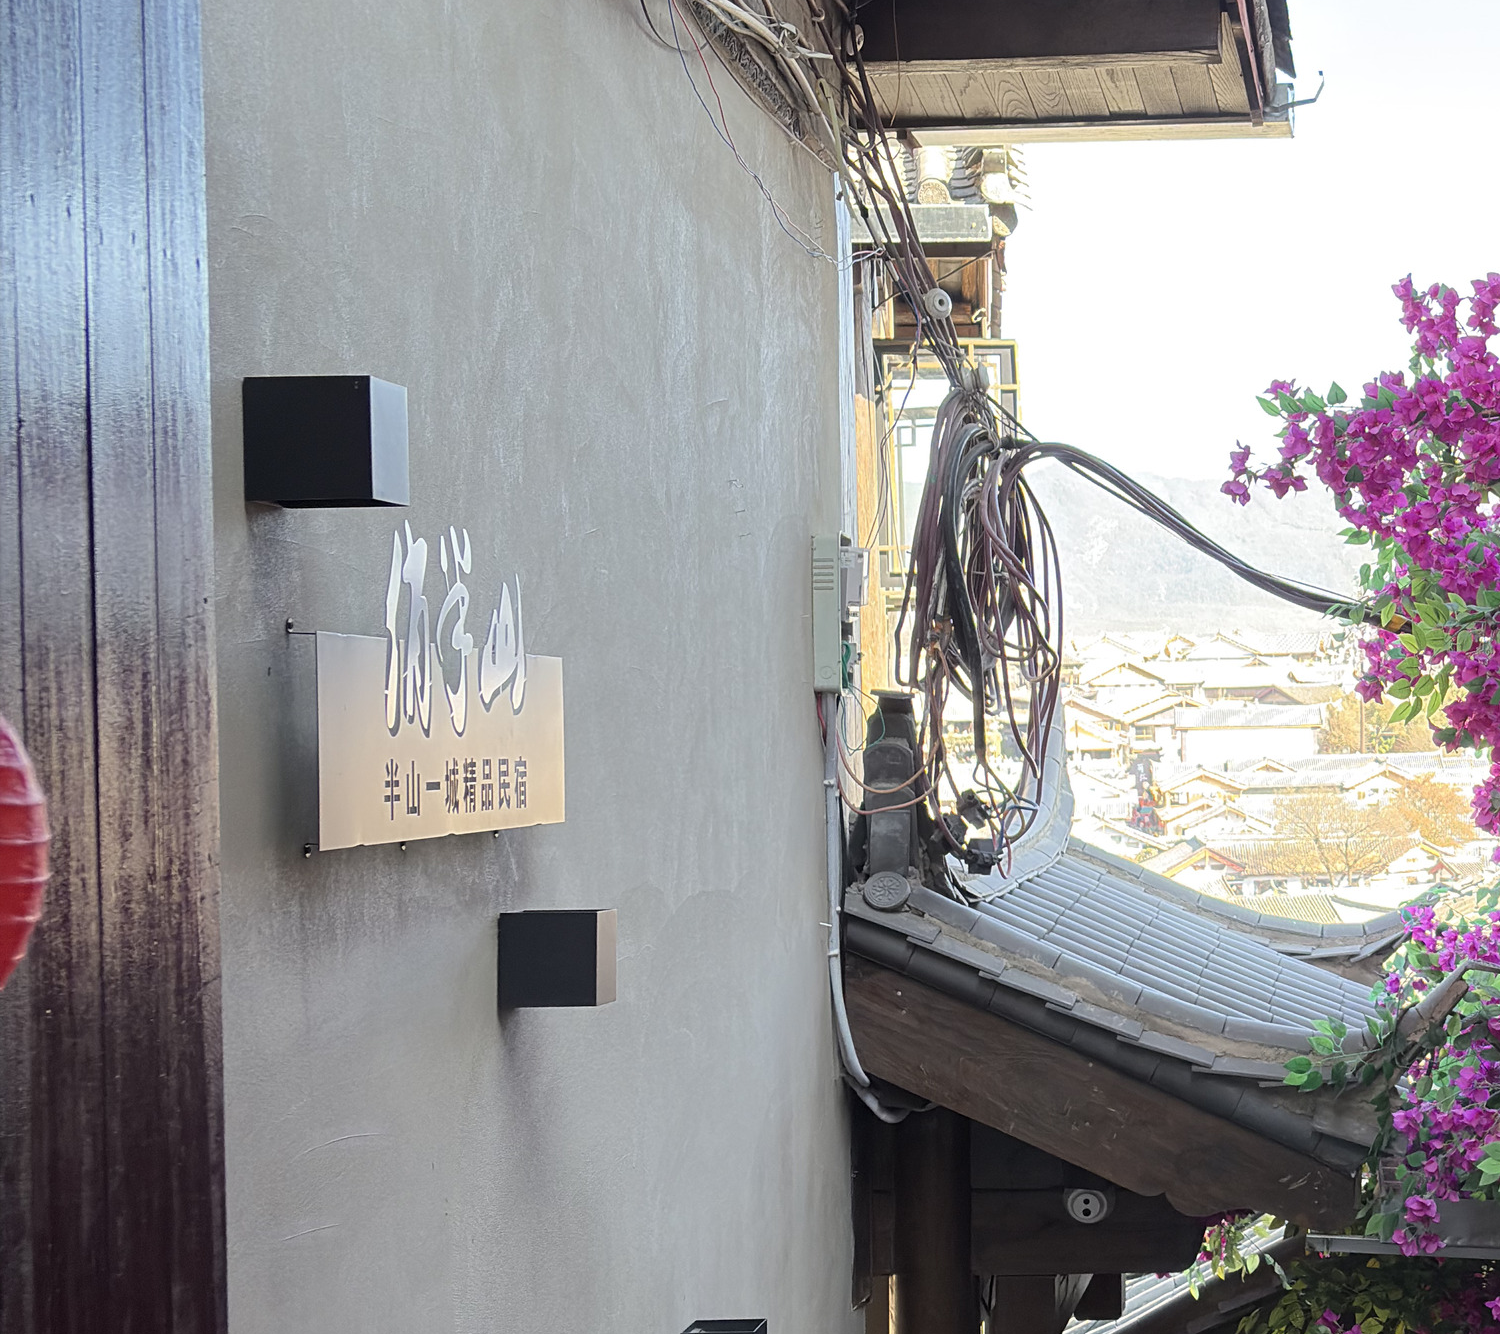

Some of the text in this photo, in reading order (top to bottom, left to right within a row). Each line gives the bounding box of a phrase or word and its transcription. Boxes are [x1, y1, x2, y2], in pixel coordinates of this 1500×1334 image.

[384, 755, 527, 821] 半山一城精品民宿
